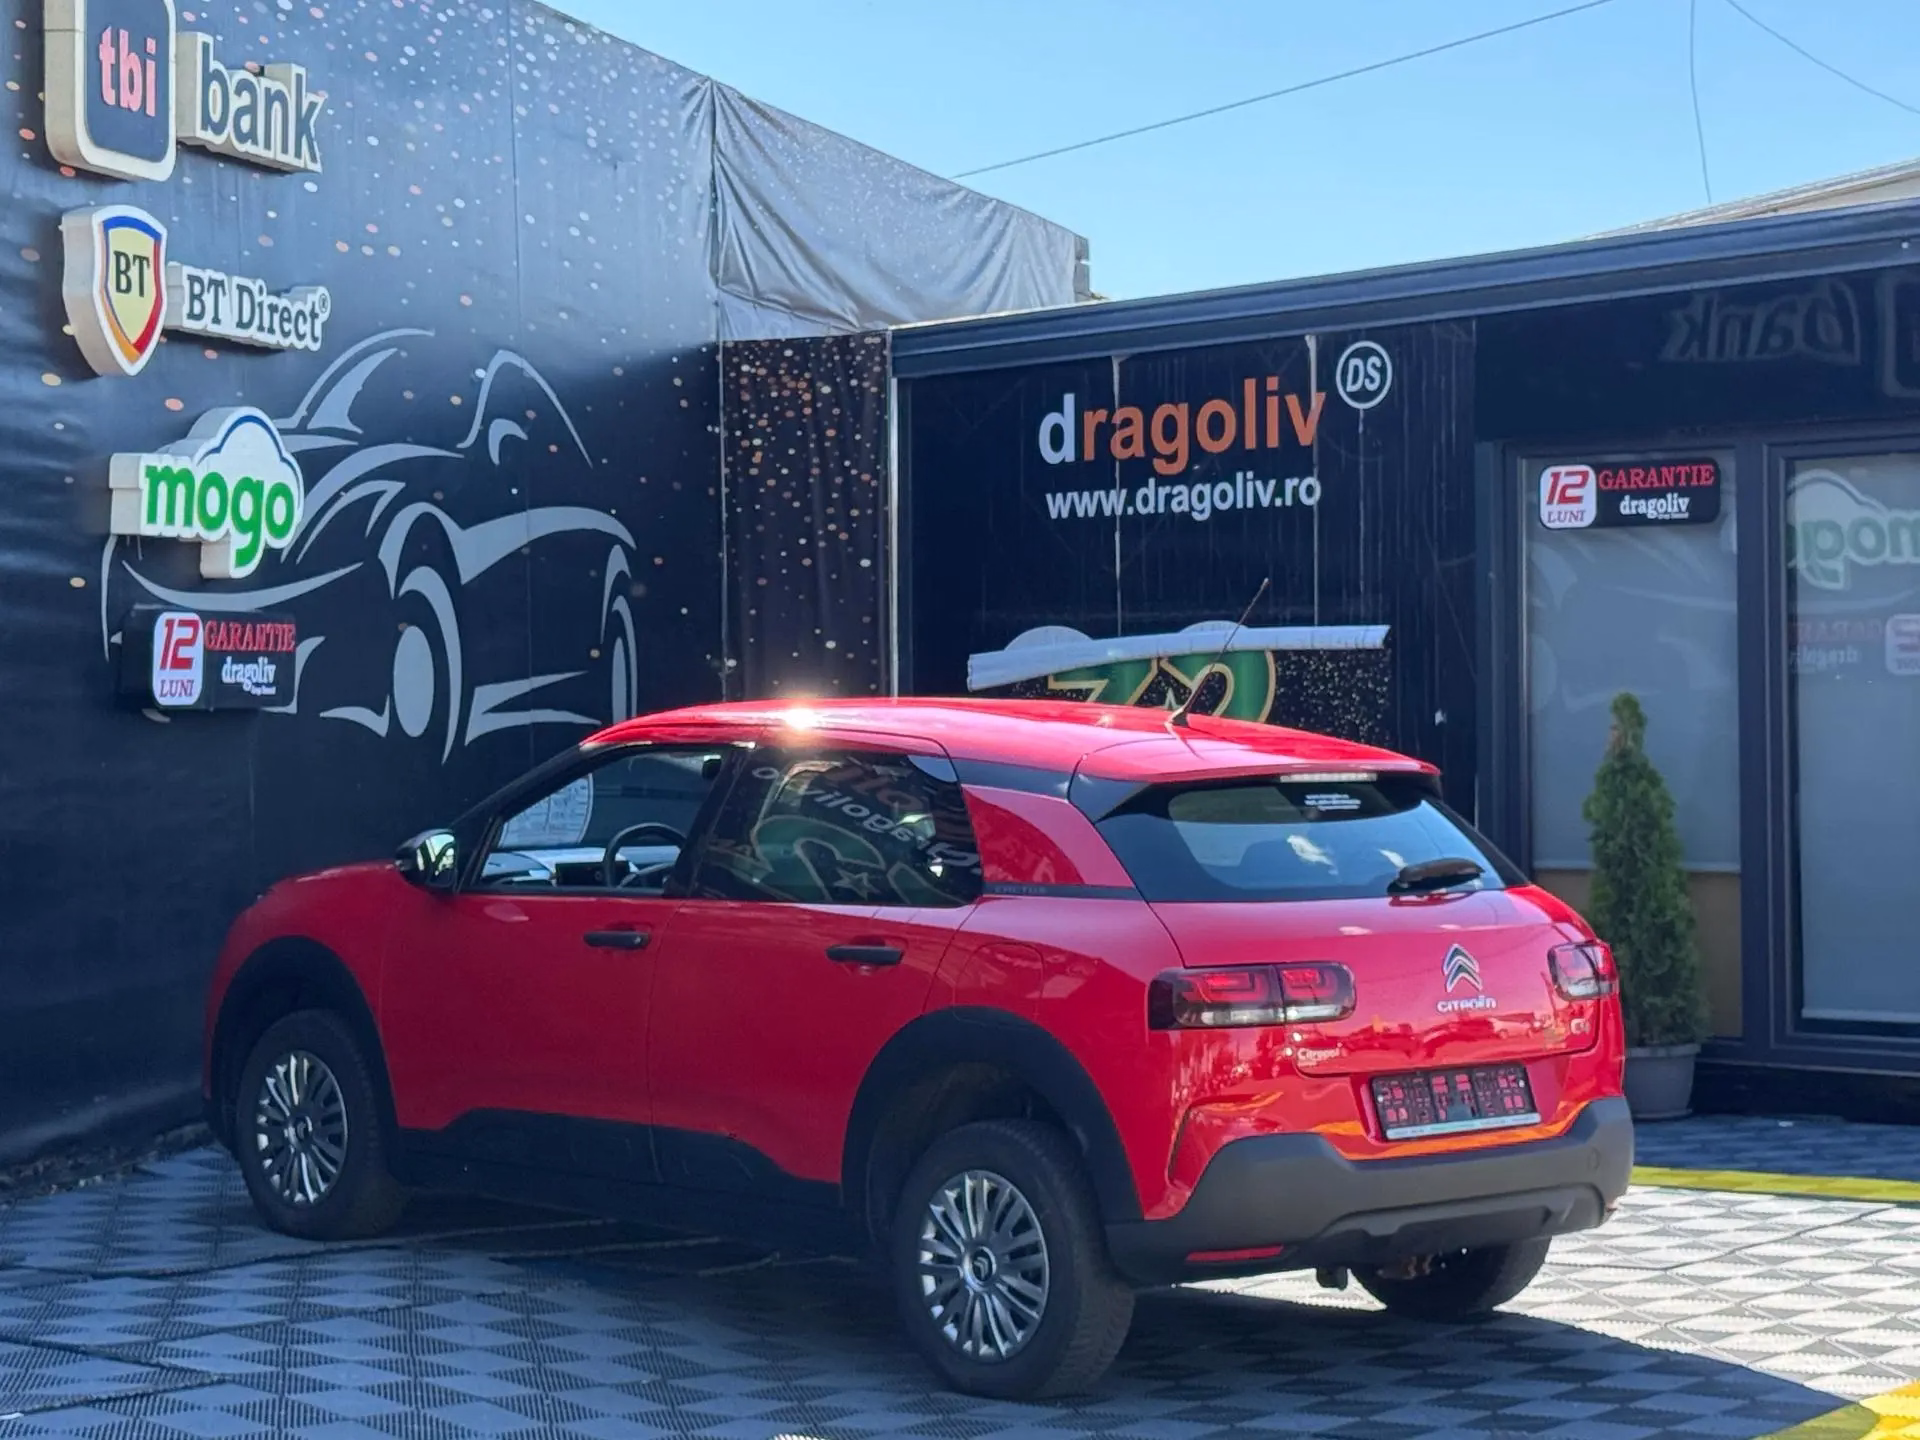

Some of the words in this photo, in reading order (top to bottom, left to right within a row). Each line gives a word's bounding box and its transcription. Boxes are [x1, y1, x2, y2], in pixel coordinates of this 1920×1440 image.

[99, 26, 156, 117] tbi
[200, 41, 323, 165] bank
[113, 250, 150, 298] BT
[187, 274, 227, 325] BT
[1347, 355, 1382, 393] DS
[1038, 375, 1327, 475] dragoliv
[1045, 470, 1322, 521] www.dragoliv.ro
[1546, 470, 1590, 505] 12
[1598, 464, 1714, 490] GARANTIE
[145, 464, 294, 568] mogo
[1547, 510, 1587, 524] LUNI
[1619, 492, 1690, 519] dragoliv
[159, 618, 200, 671] 12
[204, 619, 296, 652] GARANTIE
[159, 679, 195, 698] LUNI
[221, 656, 277, 692] dragoliv
